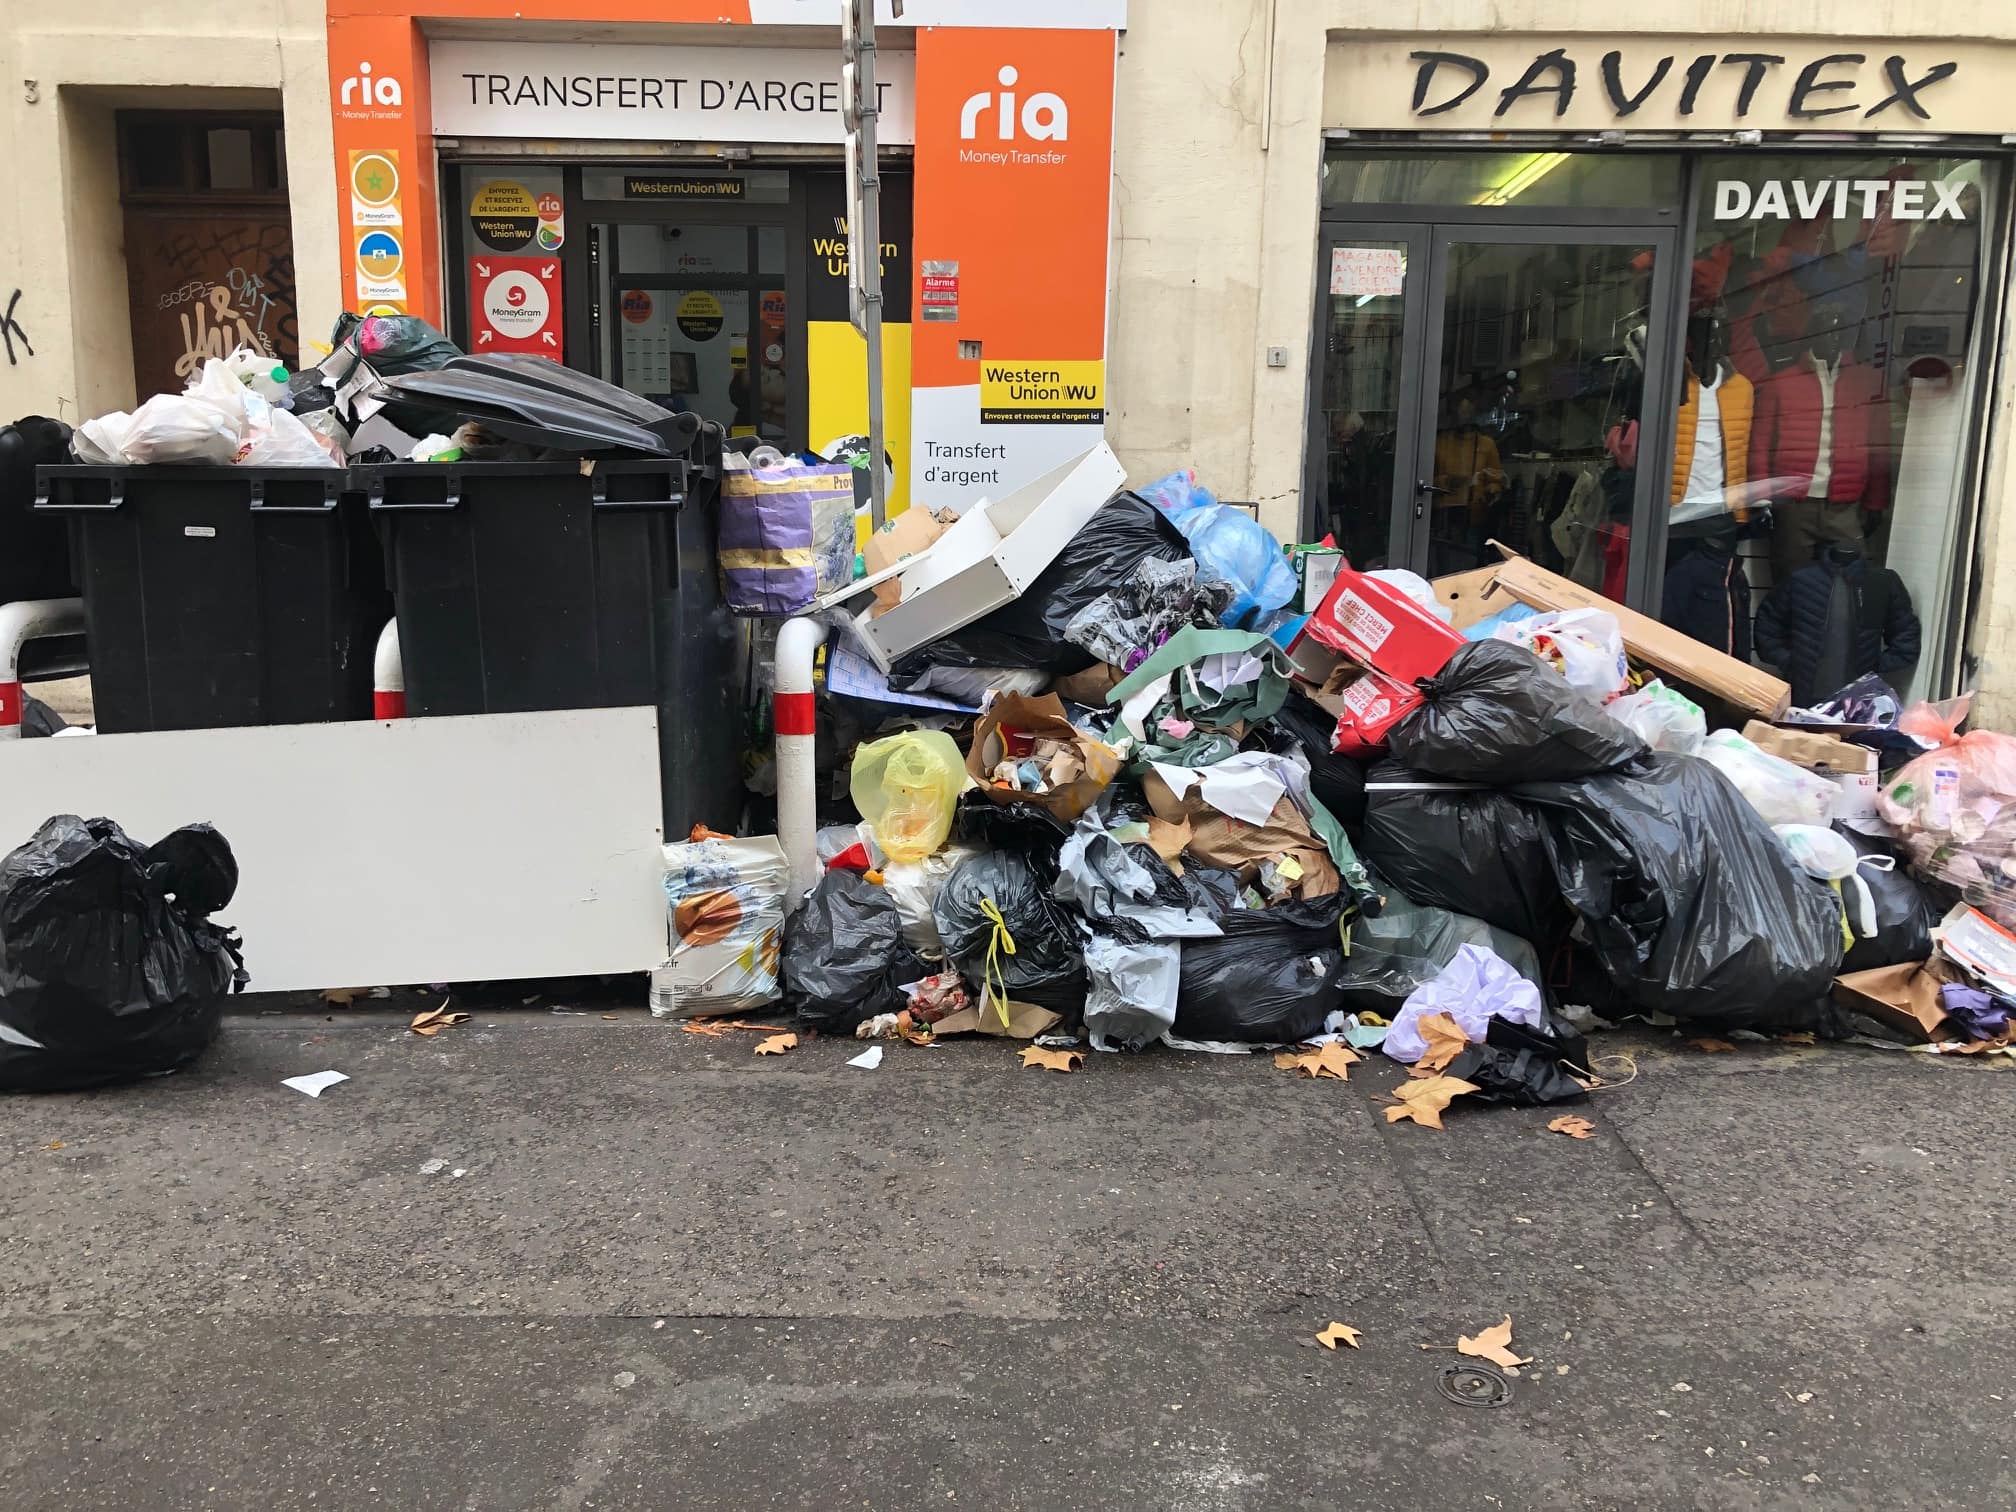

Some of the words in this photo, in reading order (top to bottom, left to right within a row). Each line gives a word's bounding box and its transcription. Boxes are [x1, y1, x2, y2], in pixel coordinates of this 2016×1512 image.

[341, 61, 402, 105] ria
[1410, 48, 1957, 120] DAVITEX
[23, 79, 39, 105] 3
[462, 73, 688, 110] TRANSFERT
[699, 79, 893, 113] D'ARGET
[960, 64, 1068, 141] ria
[342, 111, 370, 121] Money
[371, 111, 403, 119] Transfer
[960, 149, 1008, 166] Money
[1010, 149, 1067, 164] Transfer
[630, 181, 715, 194] WesternUnion
[538, 196, 560, 212] ria
[1714, 179, 1967, 220] DAVITEX
[480, 222, 514, 230] Western
[491, 230, 515, 238] Union
[812, 238, 898, 257] Wern
[926, 278, 955, 287] Alarme
[492, 308, 541, 318] MoneyGram
[986, 368, 1059, 383] Western
[1010, 384, 1059, 400] Union
[984, 413, 1013, 421] Envoyez
[1062, 413, 1089, 421] l'argent
[924, 441, 1006, 459] Transfert
[924, 466, 999, 486] d'argent
[1346, 599, 1366, 616] CHEF
[1365, 613, 1387, 634] MERCI
[1344, 688, 1361, 705] ERCI
